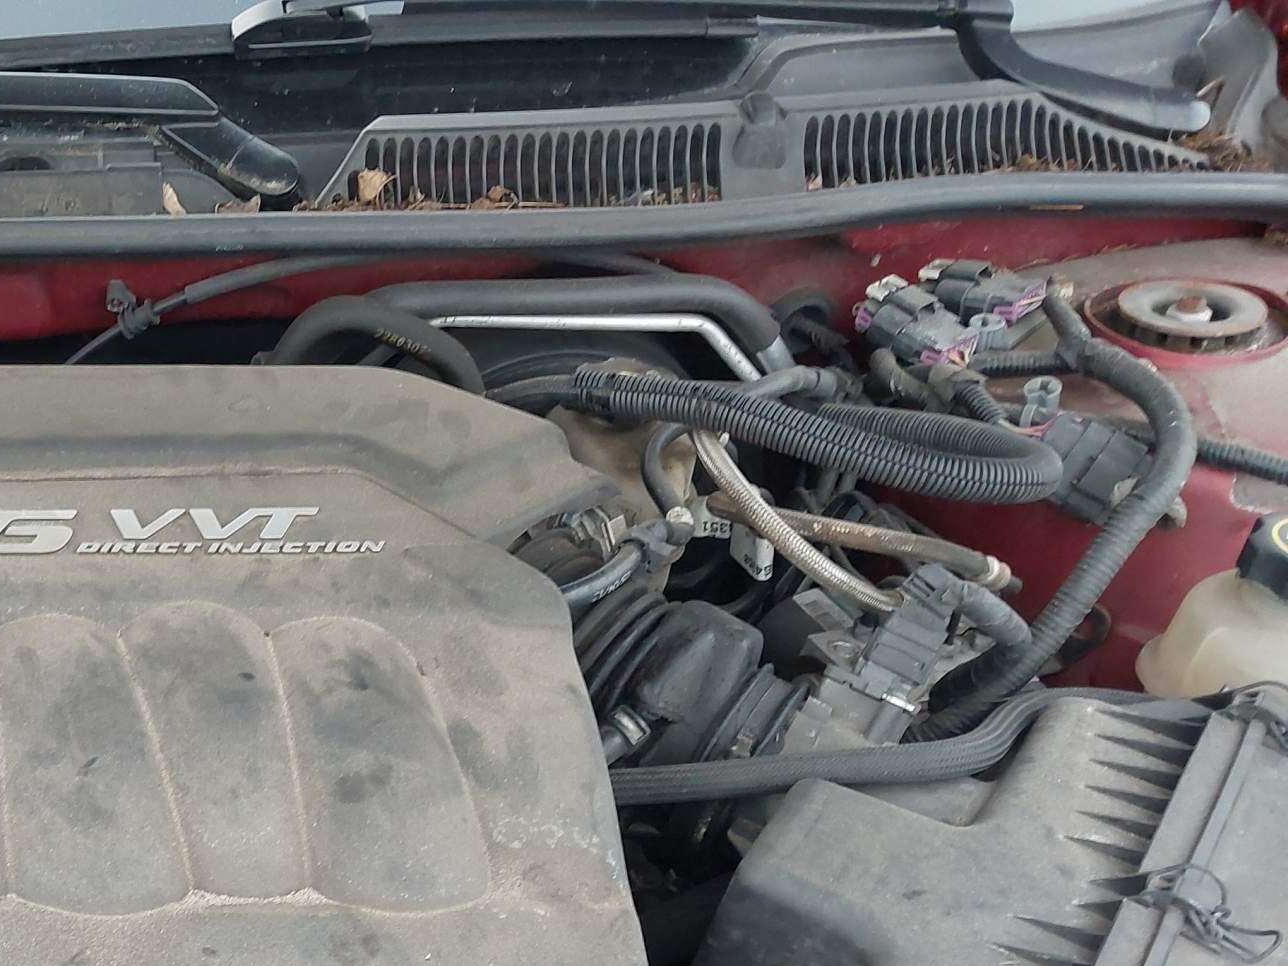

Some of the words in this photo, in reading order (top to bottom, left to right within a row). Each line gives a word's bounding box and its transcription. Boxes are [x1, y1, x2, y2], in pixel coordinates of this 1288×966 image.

[109, 506, 320, 540] VVT
[75, 541, 203, 555] DIRECT
[207, 541, 385, 555] INJECTION
